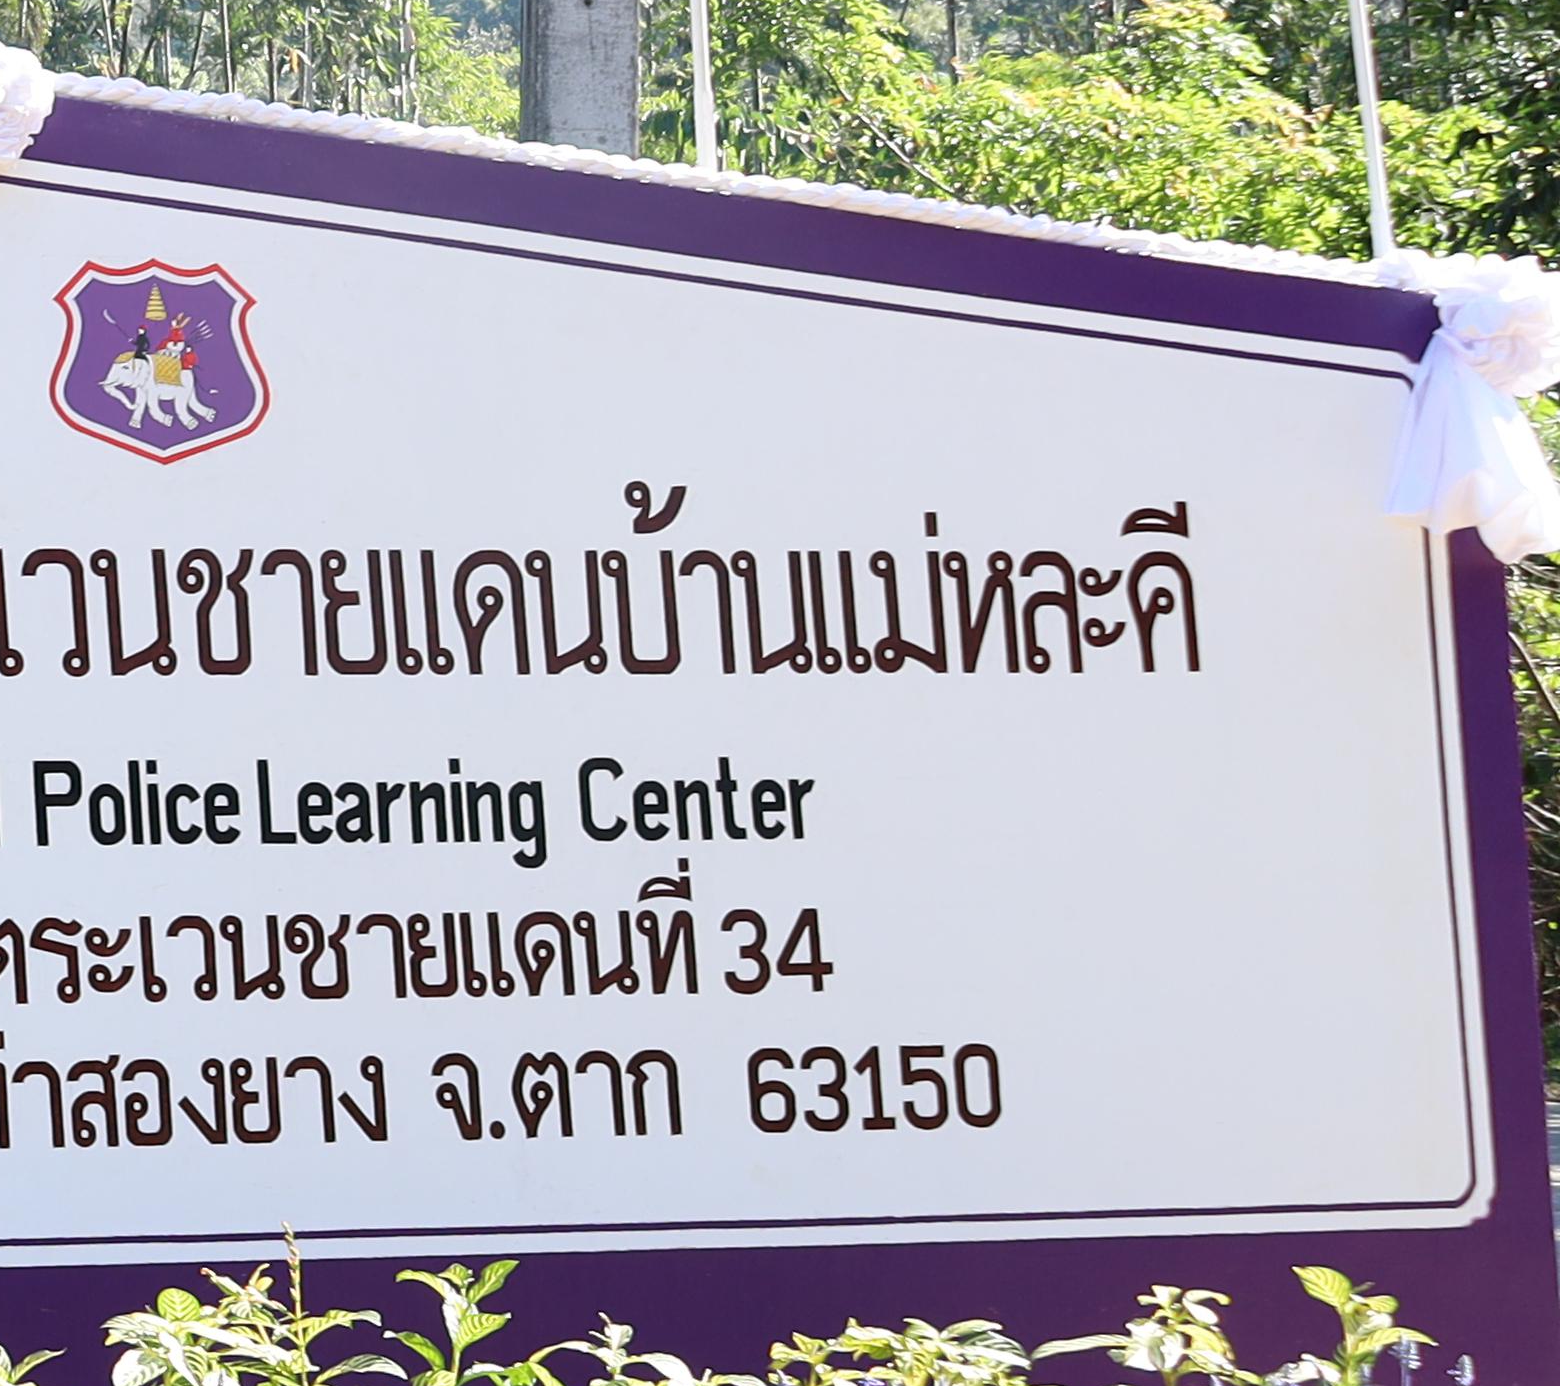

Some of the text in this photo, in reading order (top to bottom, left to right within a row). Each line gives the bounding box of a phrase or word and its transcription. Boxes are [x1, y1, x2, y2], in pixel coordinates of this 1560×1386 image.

[31, 758, 242, 848] Police
[255, 757, 548, 870] Learning
[577, 755, 816, 843] Center
[720, 908, 835, 995] 34
[431, 1049, 683, 1142] จ.ตาก
[746, 1043, 1003, 1135] 63150
